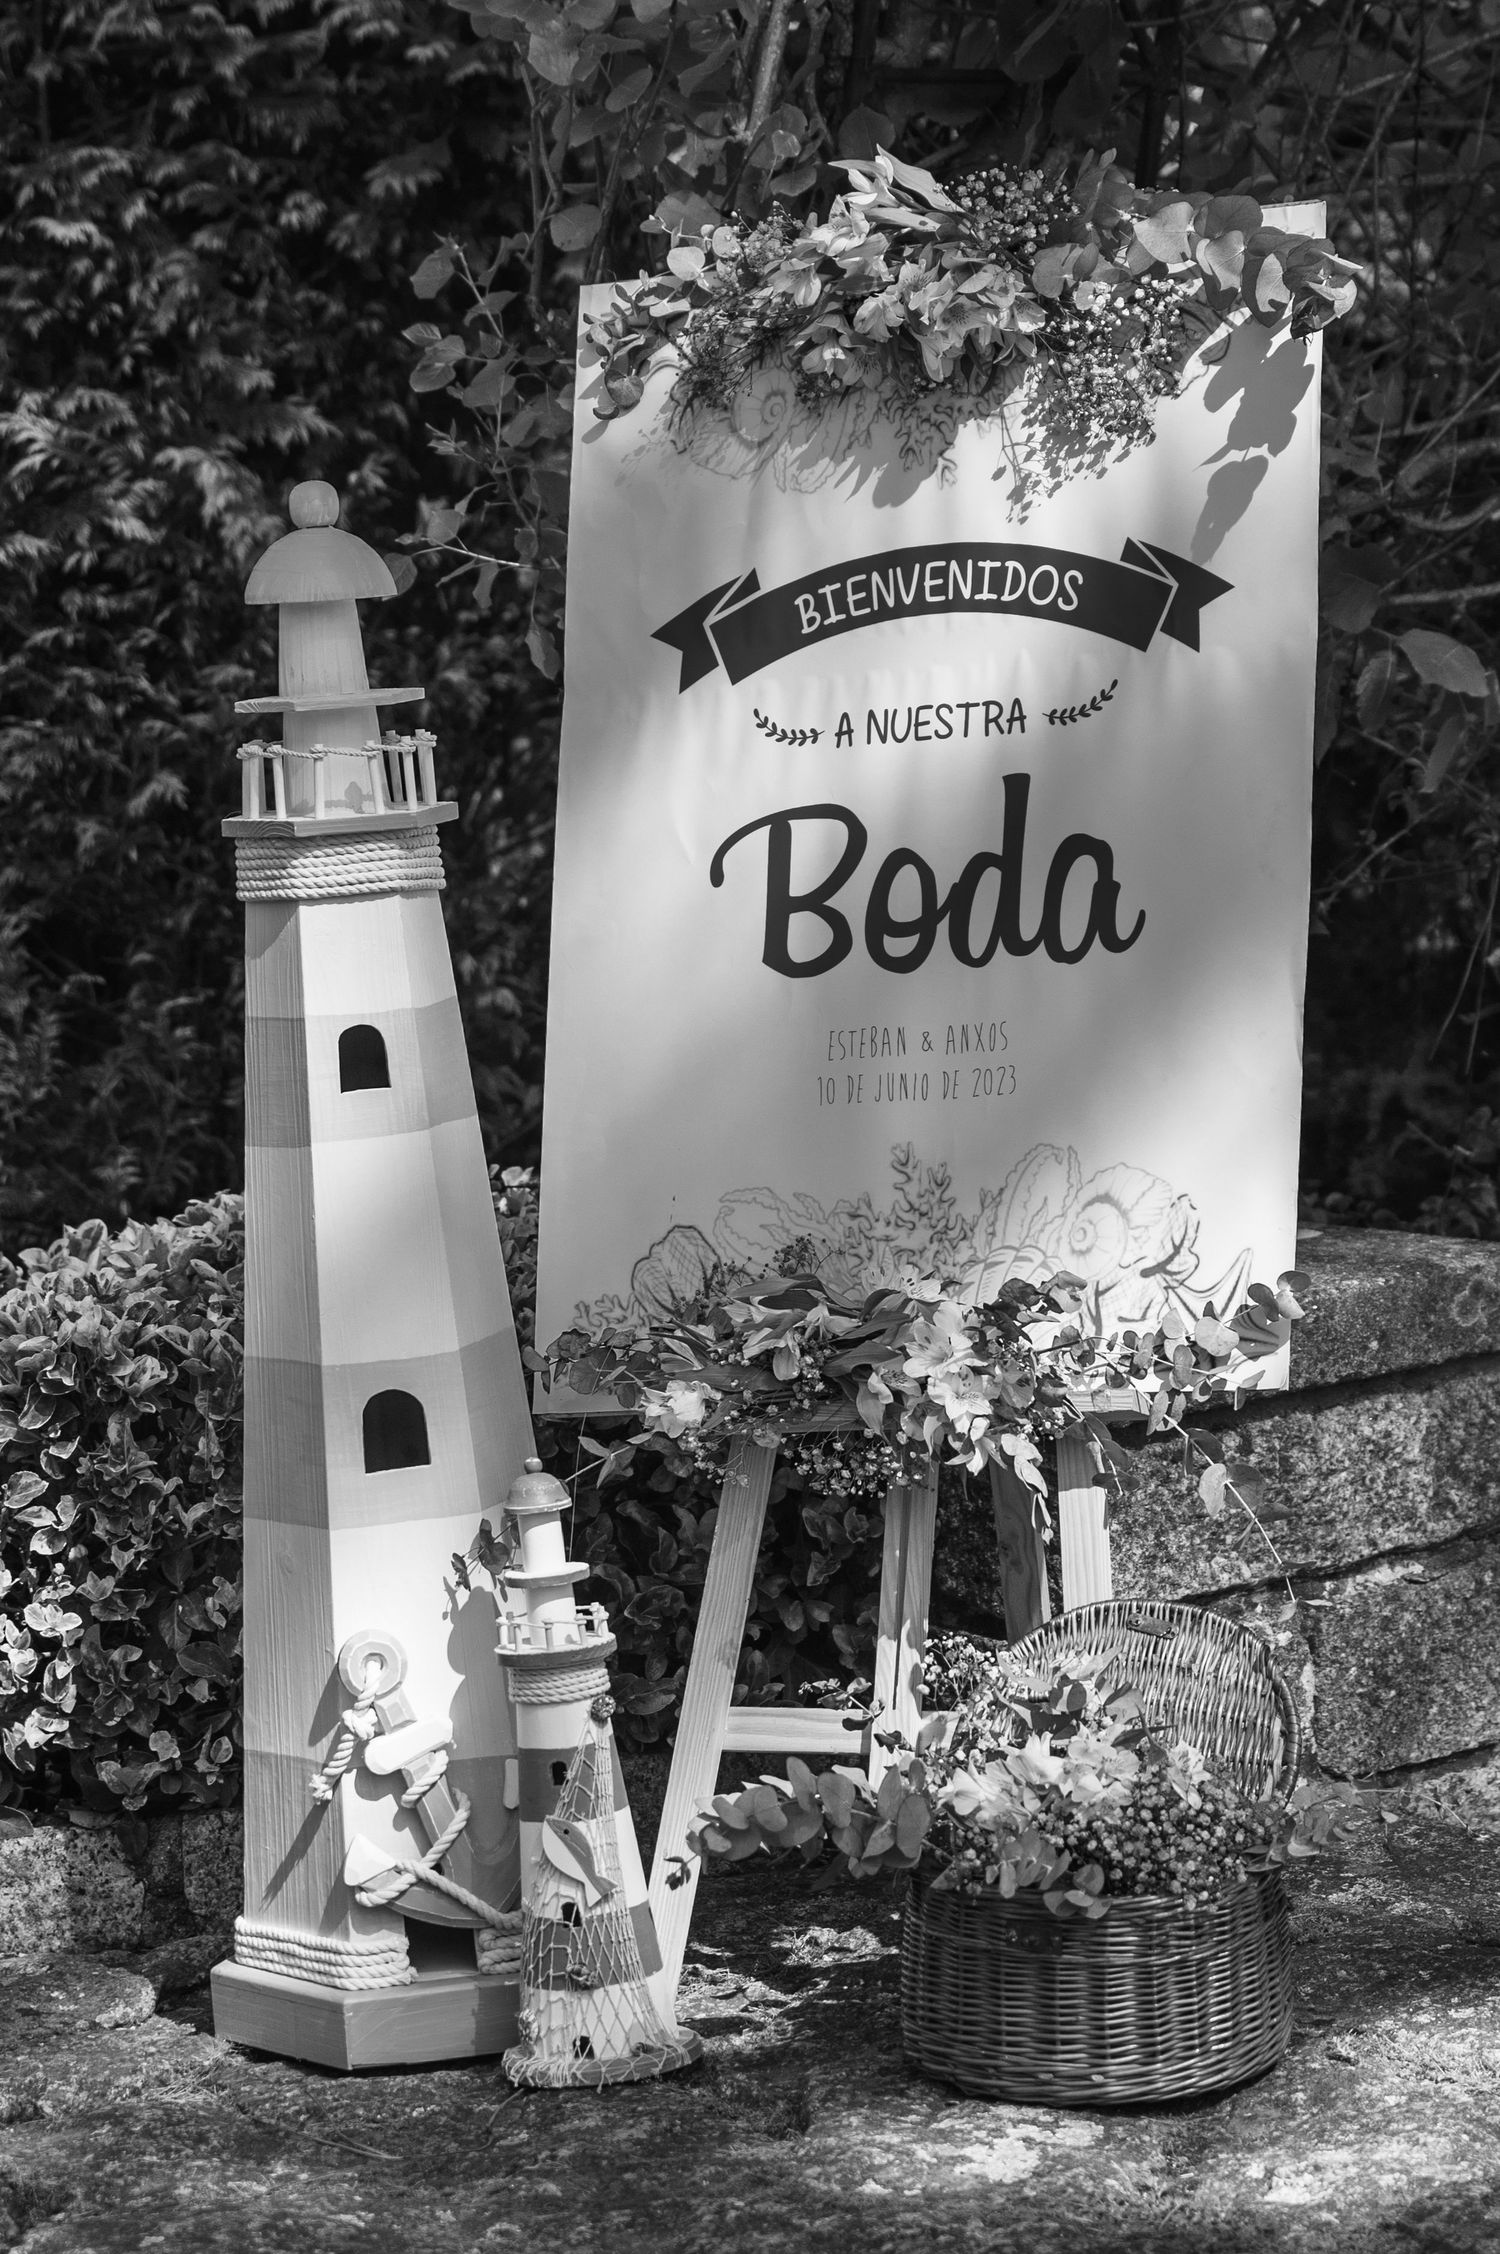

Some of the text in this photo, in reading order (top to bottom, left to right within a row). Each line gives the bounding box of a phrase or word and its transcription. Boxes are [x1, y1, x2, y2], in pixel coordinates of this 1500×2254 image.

[794, 559, 1084, 635] BIENVENIDOS
[834, 697, 1028, 749] A NUESTRA
[709, 772, 1147, 979] Boda
[827, 1020, 1009, 1062] ESTEBAN & ANXOS
[817, 1064, 1017, 1107] 10 DE JUNIO DE 2023
